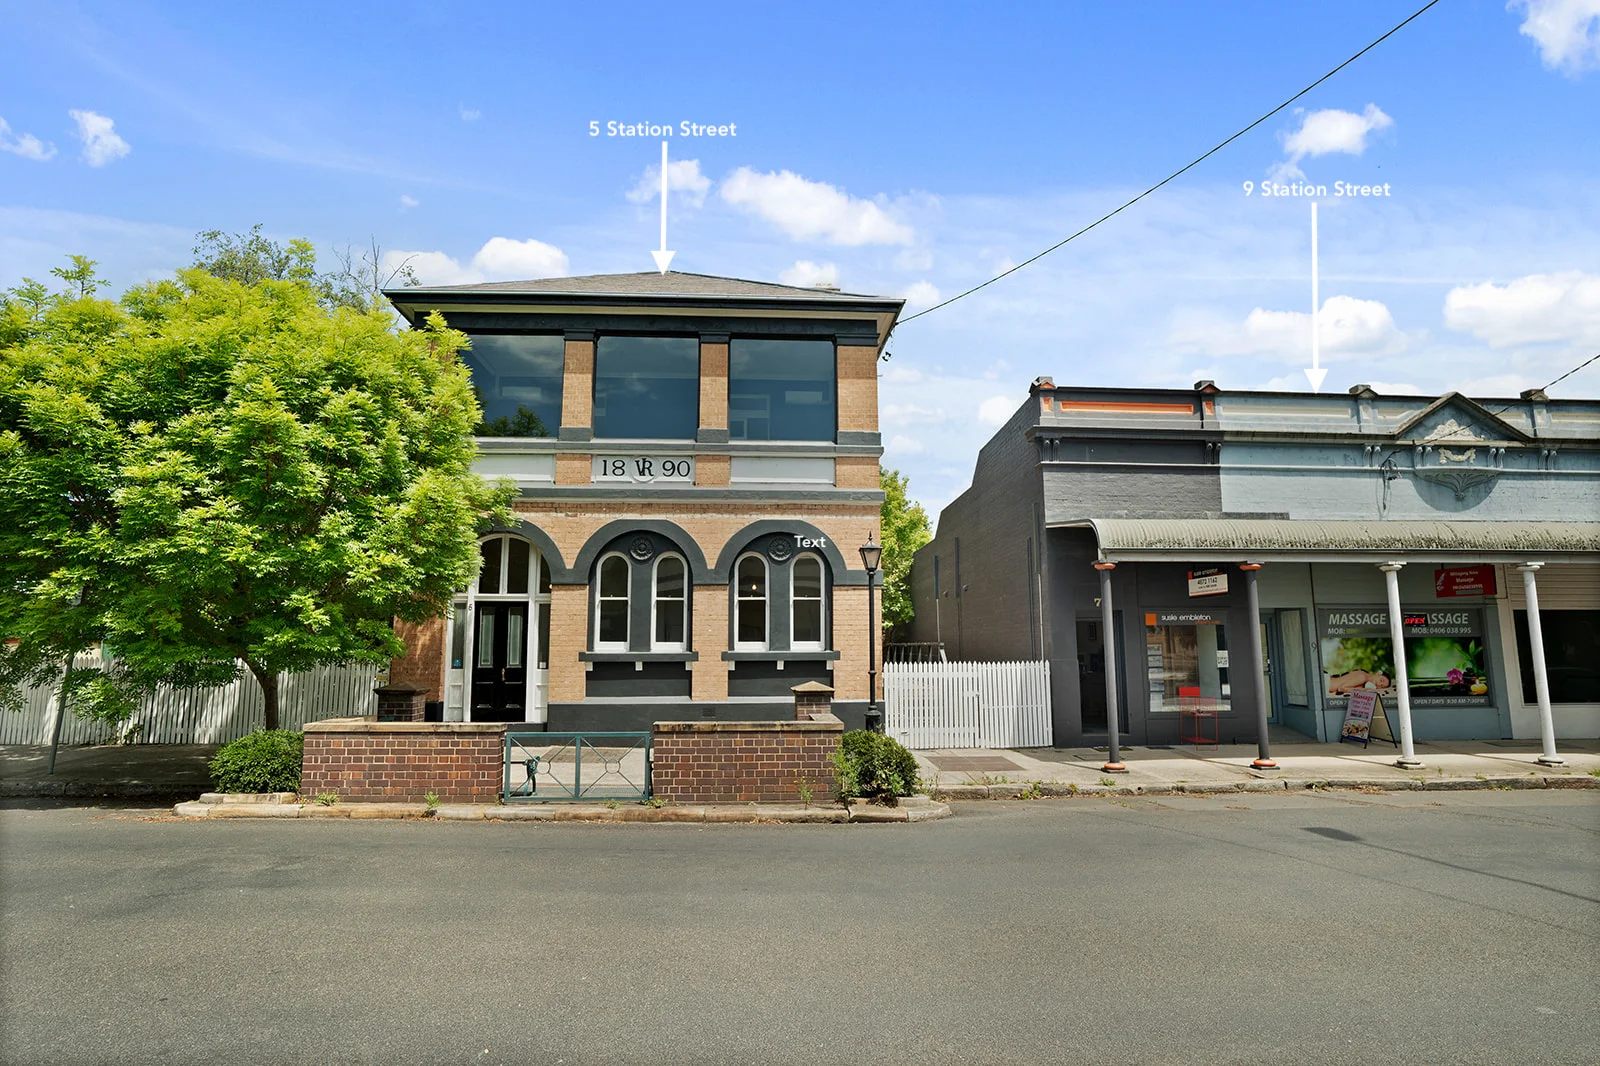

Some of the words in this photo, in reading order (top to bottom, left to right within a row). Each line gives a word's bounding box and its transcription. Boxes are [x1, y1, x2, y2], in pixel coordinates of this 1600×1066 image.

[602, 459, 626, 476] 18
[662, 460, 691, 477] 90
[1094, 597, 1102, 607] 7
[1161, 613, 1178, 621] susie
[1179, 613, 1211, 621] embleton
[1328, 613, 1387, 625] MASSAGE
[1404, 617, 1425, 625] OPEN
[1327, 627, 1346, 635] MOB:
[1353, 692, 1374, 702] Massage
